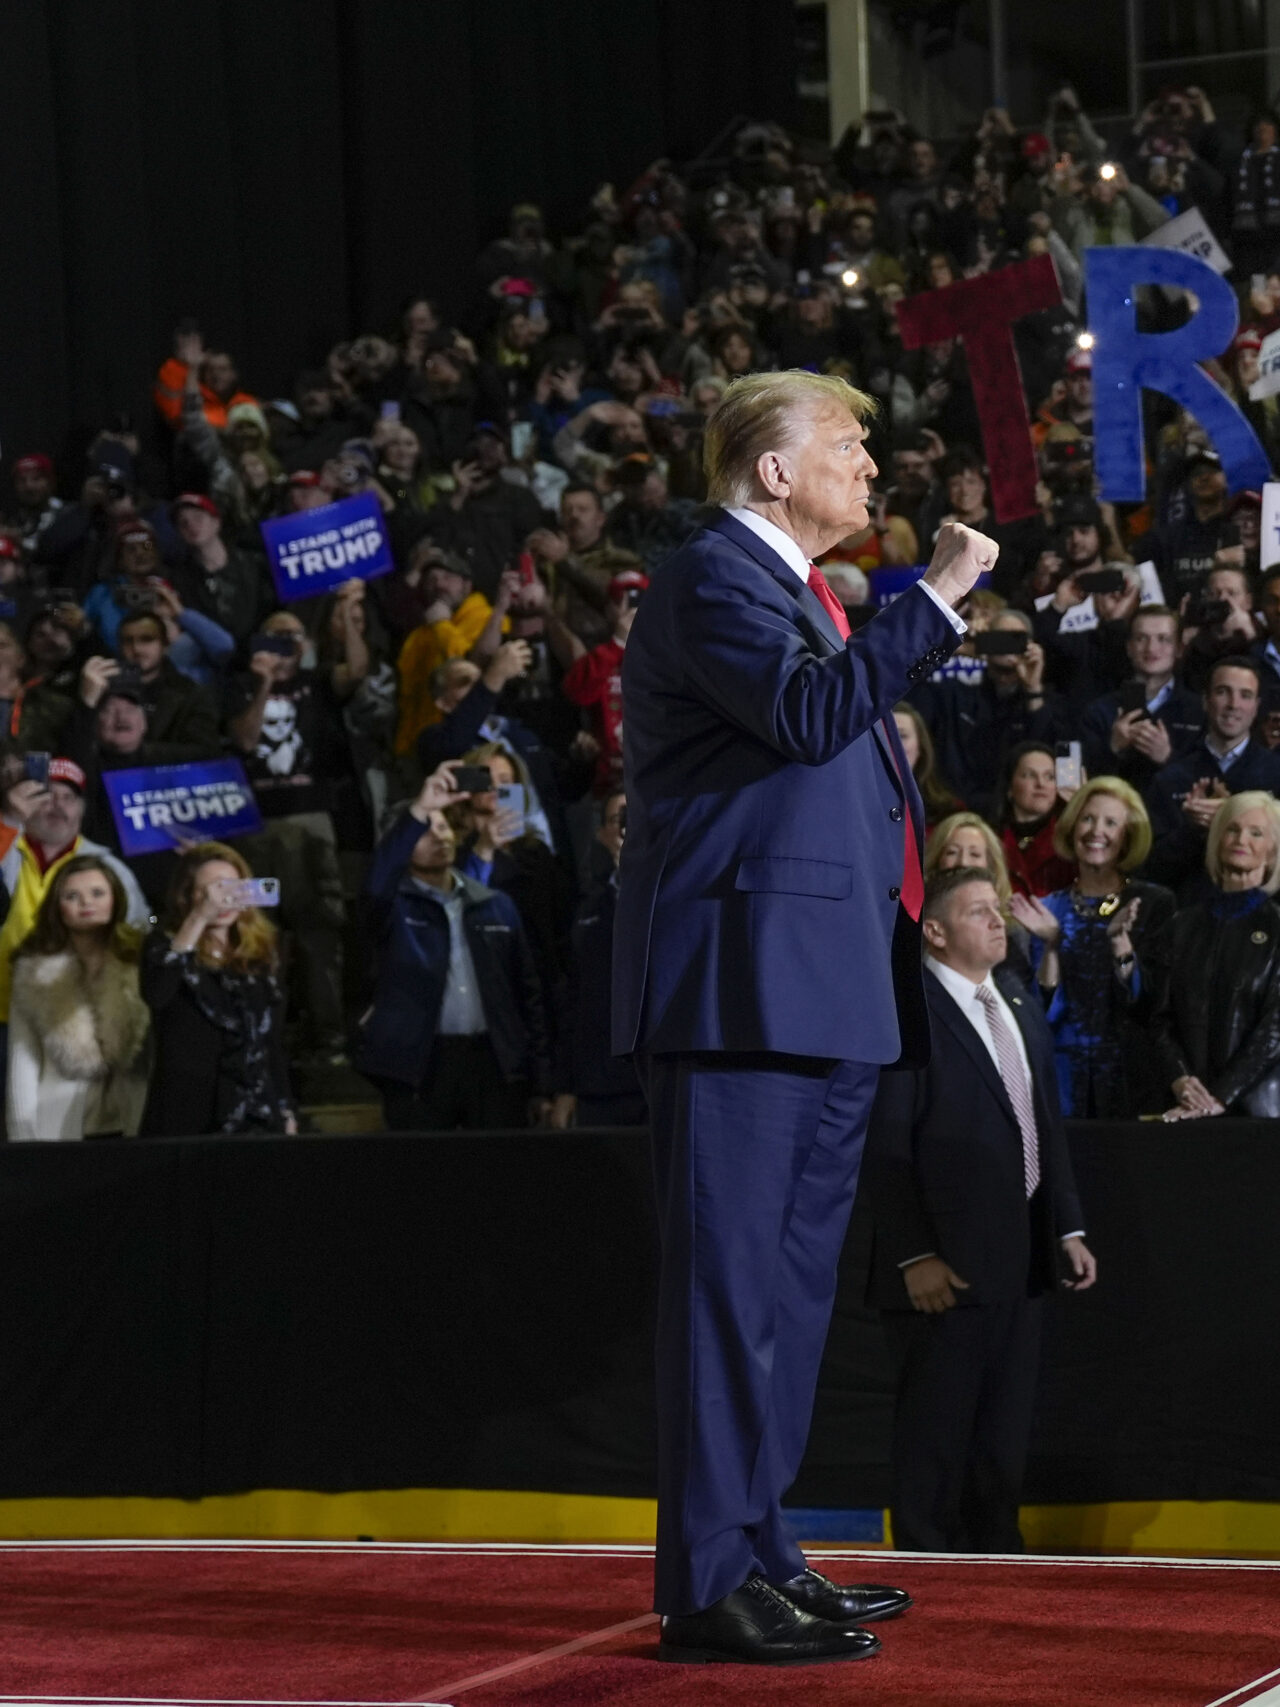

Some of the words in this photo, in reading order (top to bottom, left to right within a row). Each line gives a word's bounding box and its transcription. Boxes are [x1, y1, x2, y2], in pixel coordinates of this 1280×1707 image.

[278, 543, 286, 558] I
[288, 530, 341, 554] STAND
[341, 517, 378, 541] WITH
[280, 531, 383, 580] TRUMP
[133, 786, 188, 805] STAND
[191, 780, 238, 799] WITH
[123, 794, 247, 831] TRUMP
